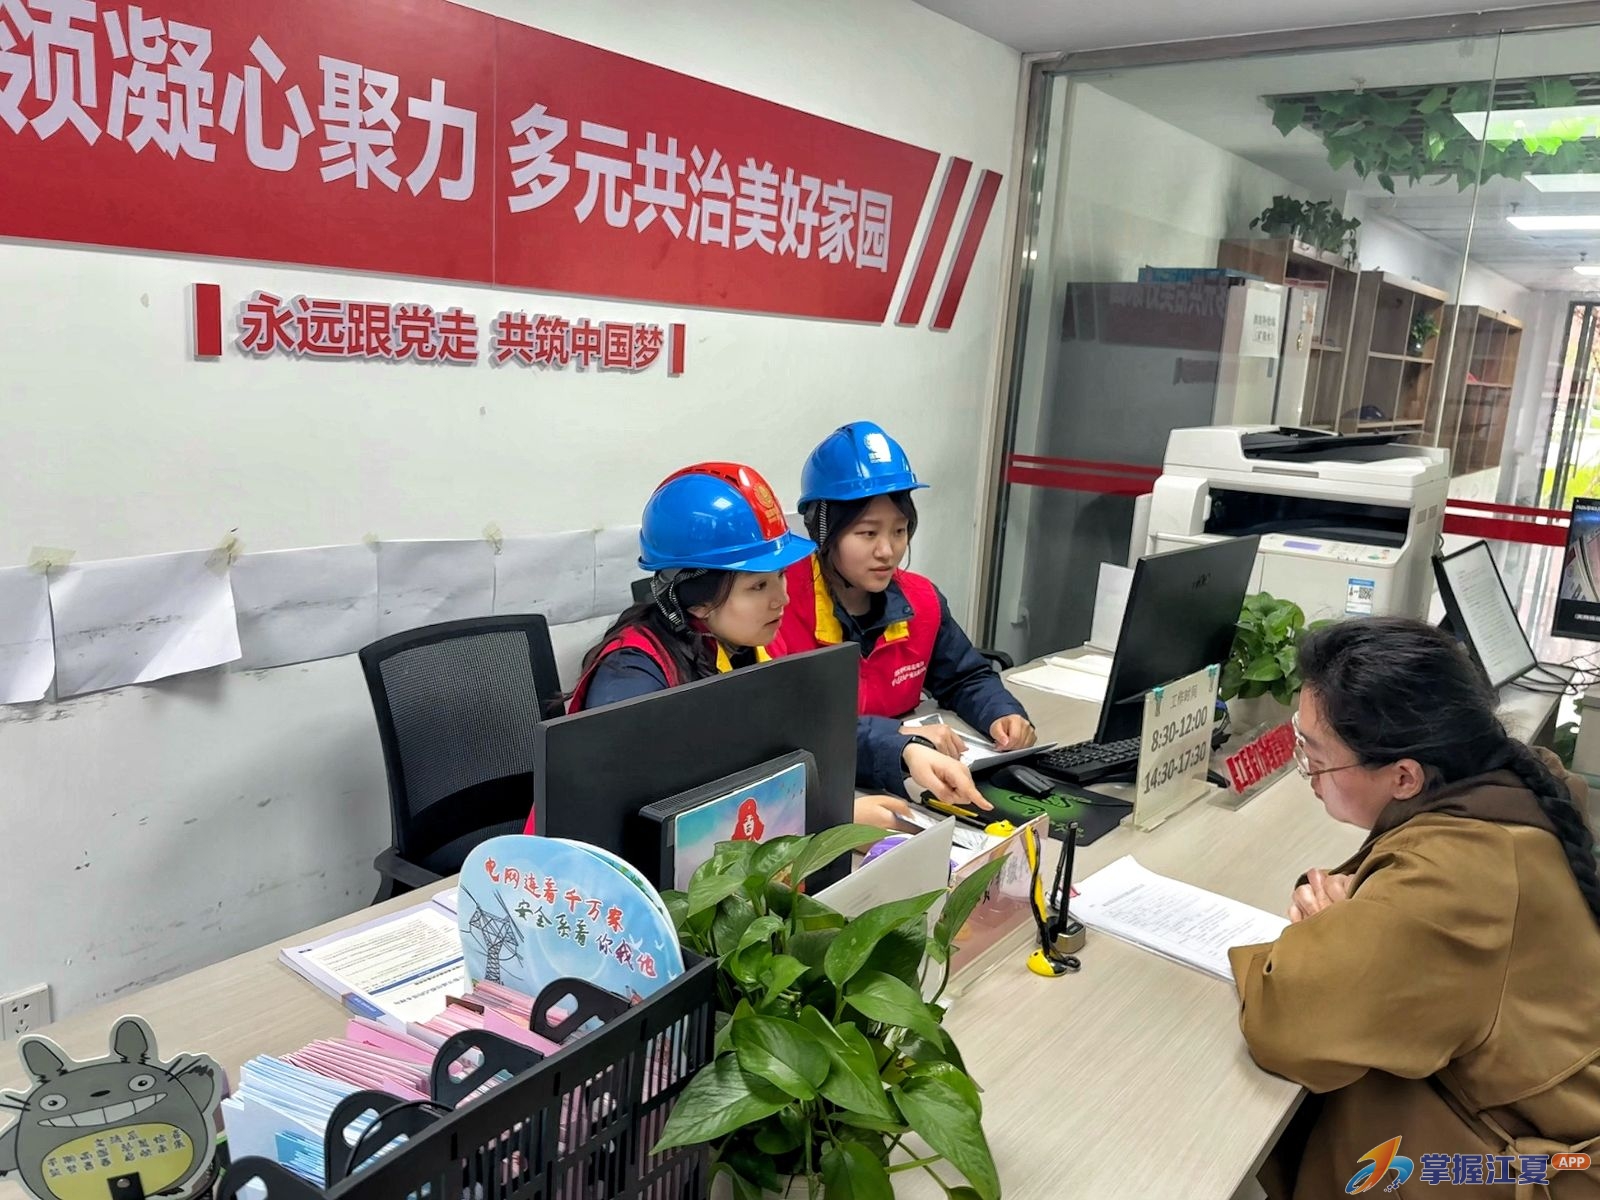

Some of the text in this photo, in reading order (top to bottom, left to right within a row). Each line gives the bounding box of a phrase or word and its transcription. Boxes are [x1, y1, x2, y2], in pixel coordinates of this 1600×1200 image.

[0, 0, 893, 272] 领凝心聚力 多元共治美好家园
[240, 292, 666, 371] 永远跟党走 共筑中国梦
[1150, 705, 1208, 752] 8:30-12:00
[1143, 740, 1207, 794] 14:30-17:30
